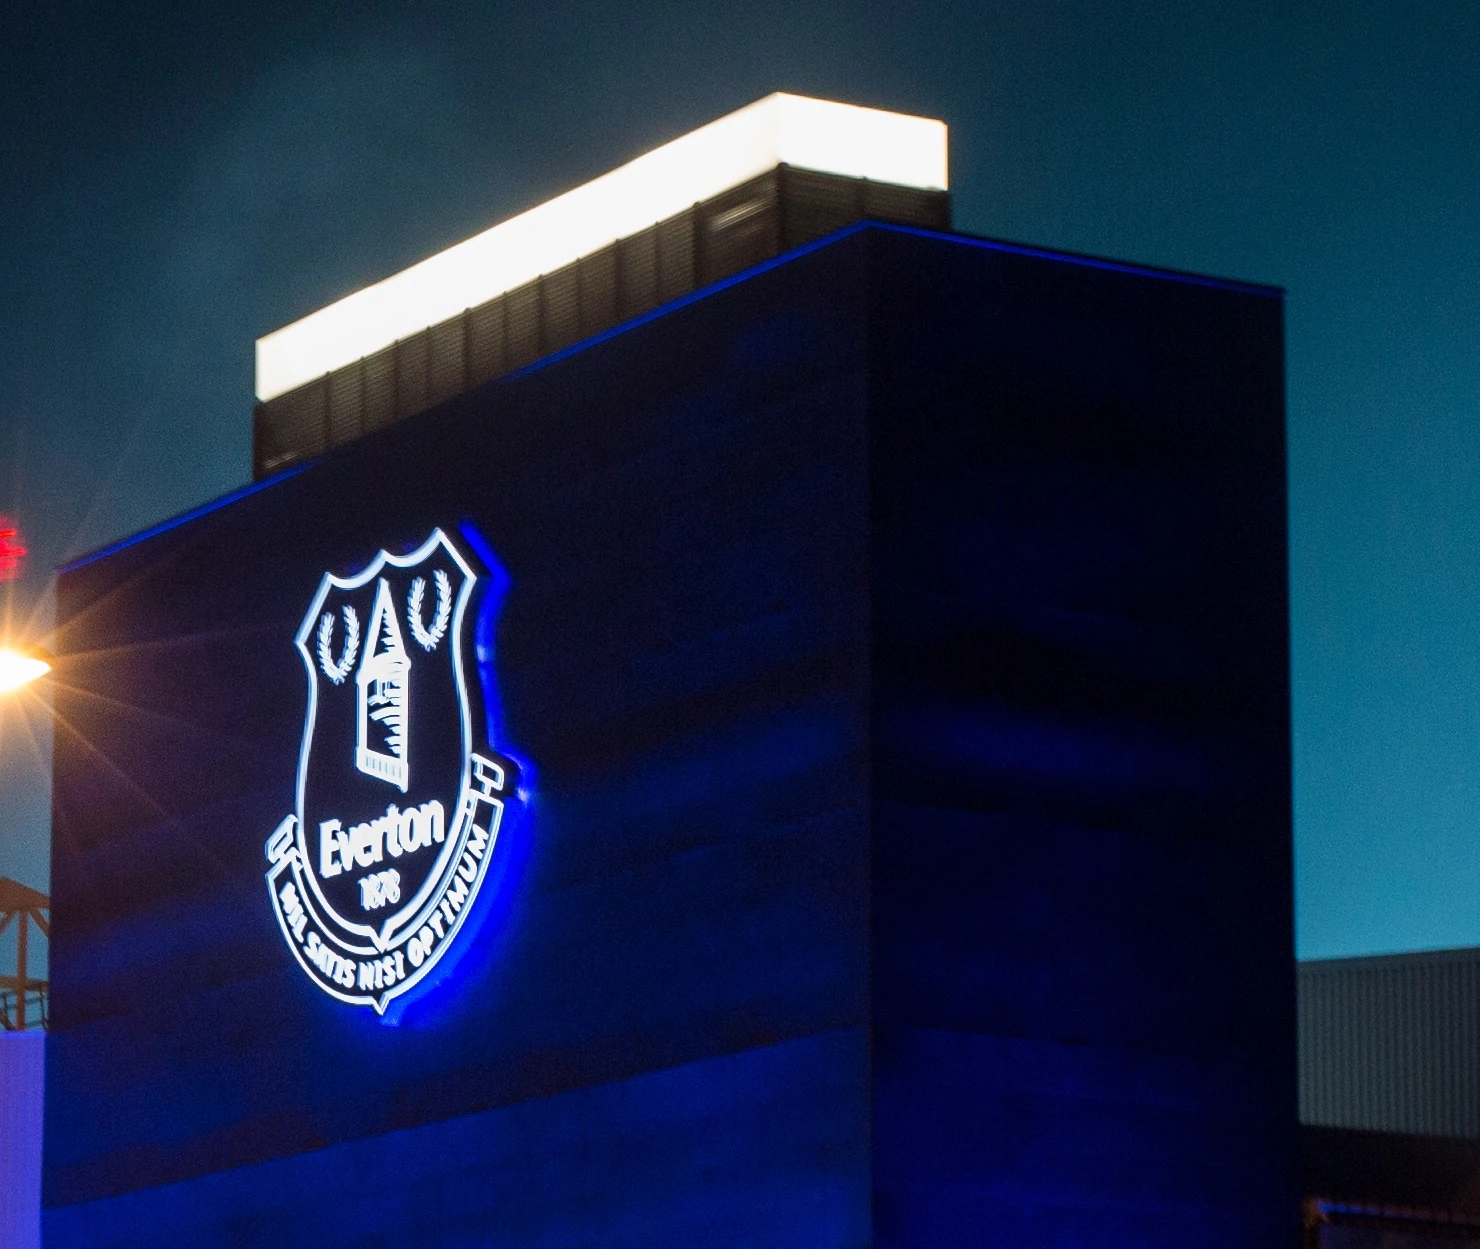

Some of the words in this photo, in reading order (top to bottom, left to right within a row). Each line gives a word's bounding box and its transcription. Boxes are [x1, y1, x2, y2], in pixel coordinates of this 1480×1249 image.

[319, 800, 444, 878] Everton
[303, 931, 357, 988] SATIS
[357, 950, 406, 990] NISI
[406, 823, 489, 967] OPTIMUM
[358, 868, 401, 910] 1878
